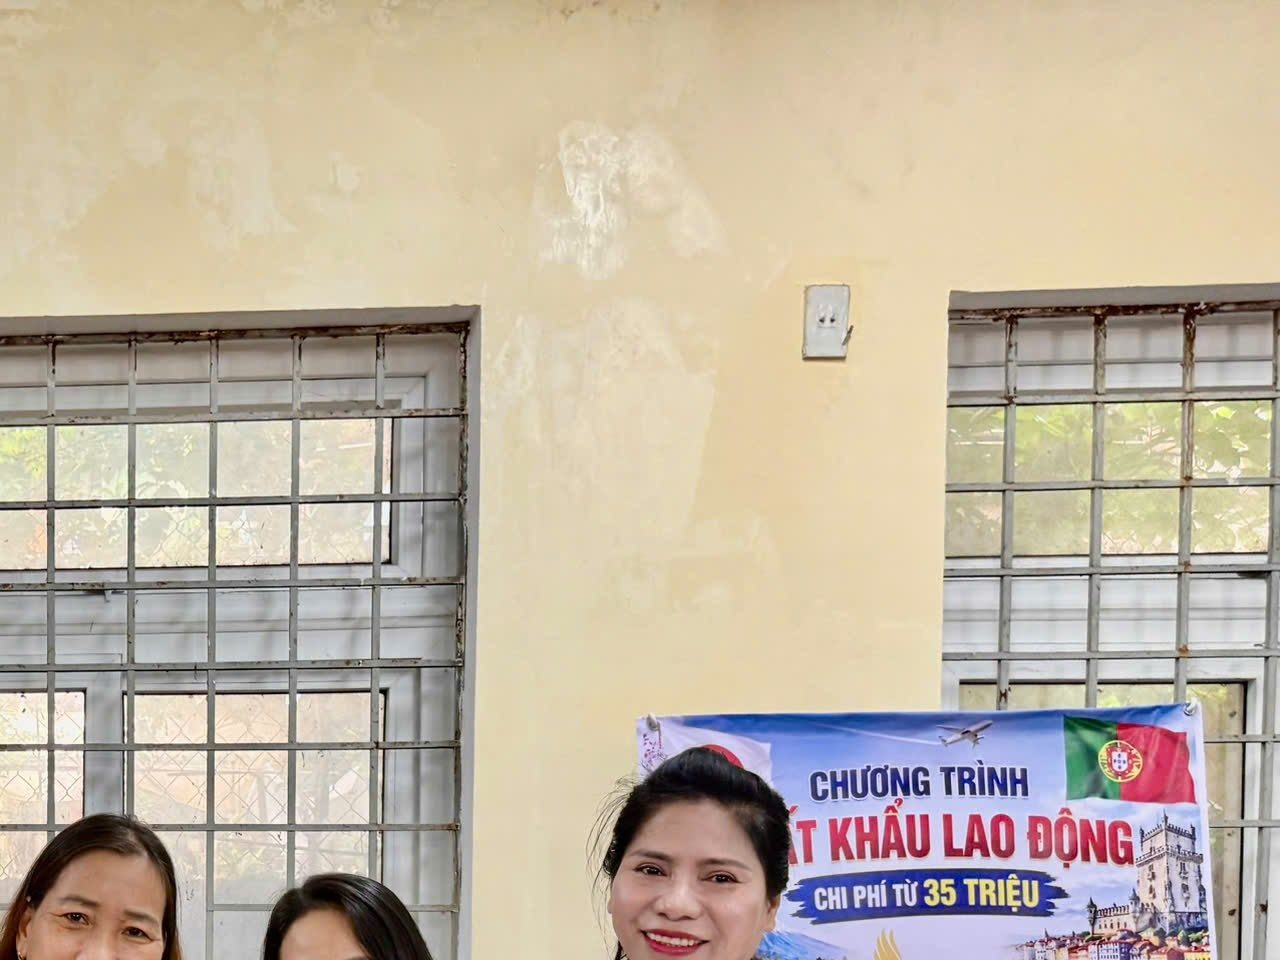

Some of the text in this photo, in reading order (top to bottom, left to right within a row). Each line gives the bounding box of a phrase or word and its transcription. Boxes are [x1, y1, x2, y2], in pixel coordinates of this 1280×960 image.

[810, 759, 1029, 801] CHƯƠNG TRÌNH
[828, 798, 931, 863] KHẨU
[943, 812, 1015, 860] LAO
[1027, 808, 1134, 868] ĐỘNG
[814, 873, 1040, 912] CHI PHÍ TỪ 35 TRIỆU
